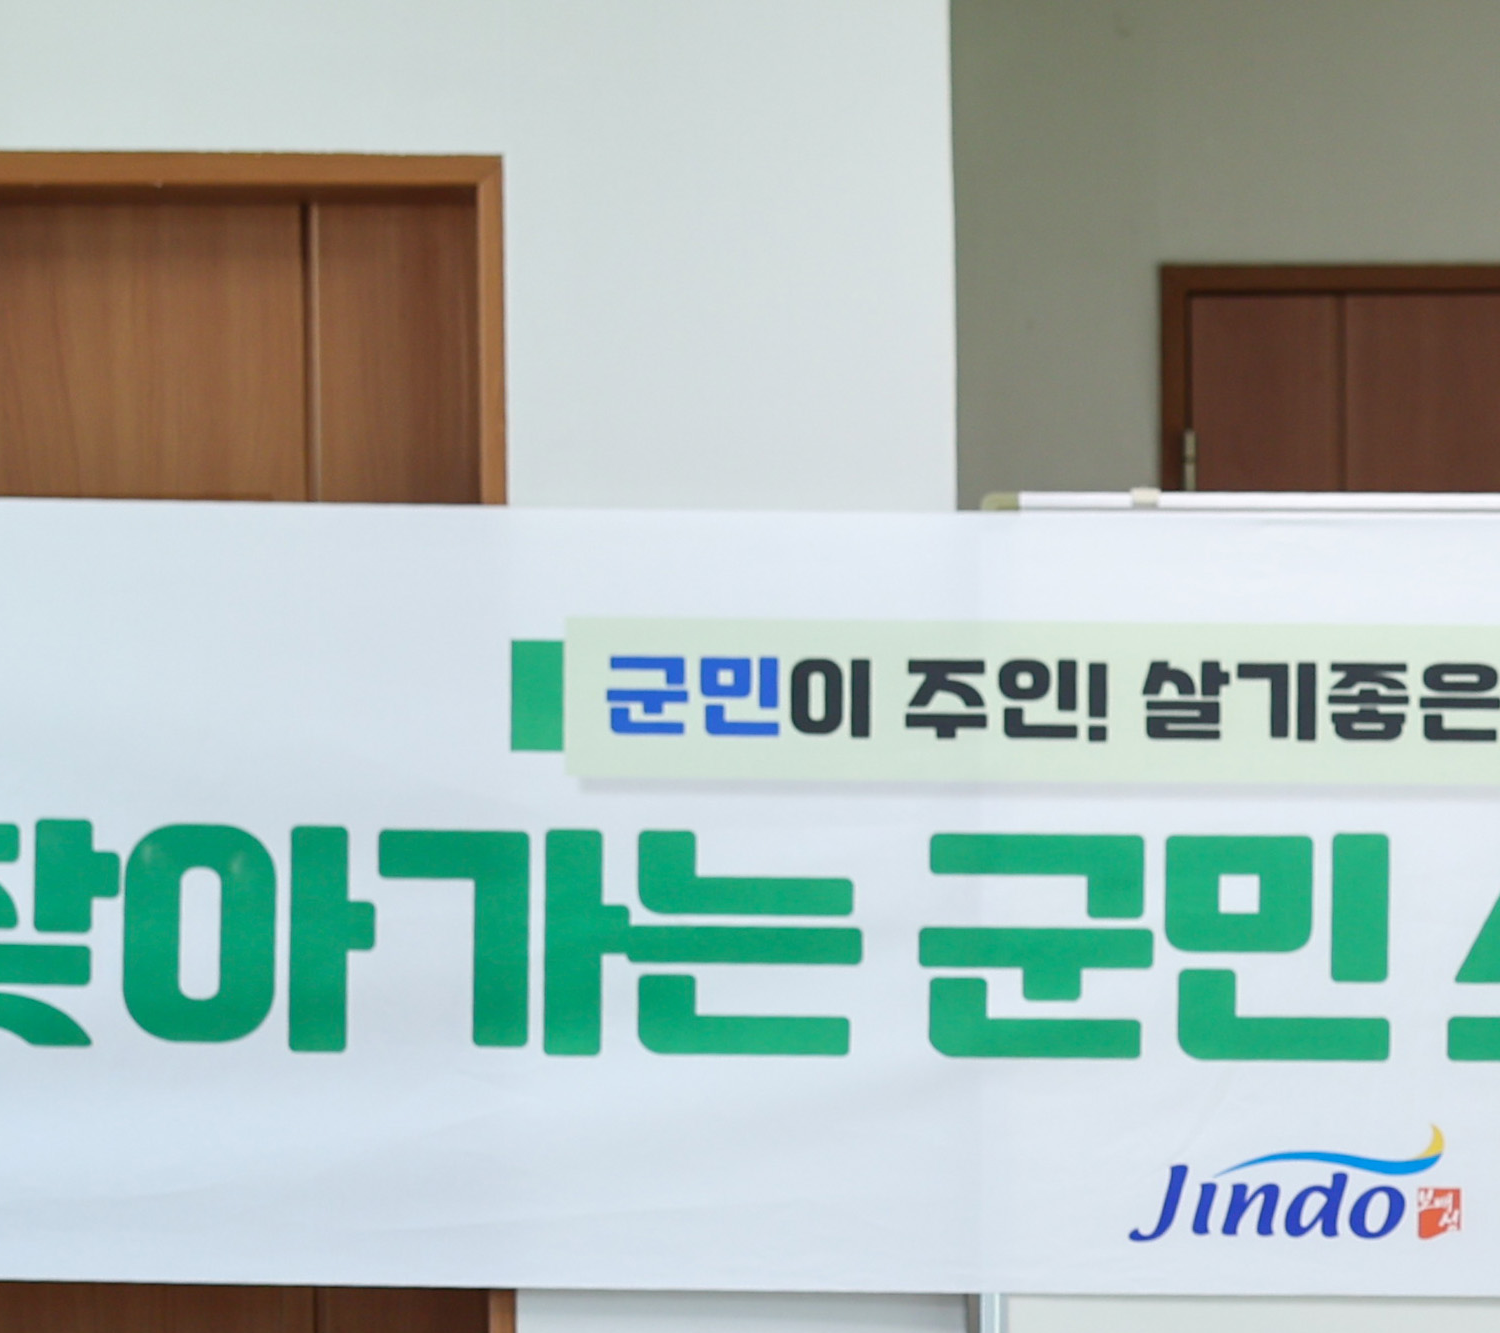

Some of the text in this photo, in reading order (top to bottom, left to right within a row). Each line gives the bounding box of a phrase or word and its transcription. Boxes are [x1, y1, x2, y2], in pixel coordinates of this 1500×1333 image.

[604, 655, 872, 739] 군민이
[903, 658, 1109, 743] 주인!
[919, 833, 1391, 1061] 군민
[1127, 1164, 1407, 1243] Jindo
